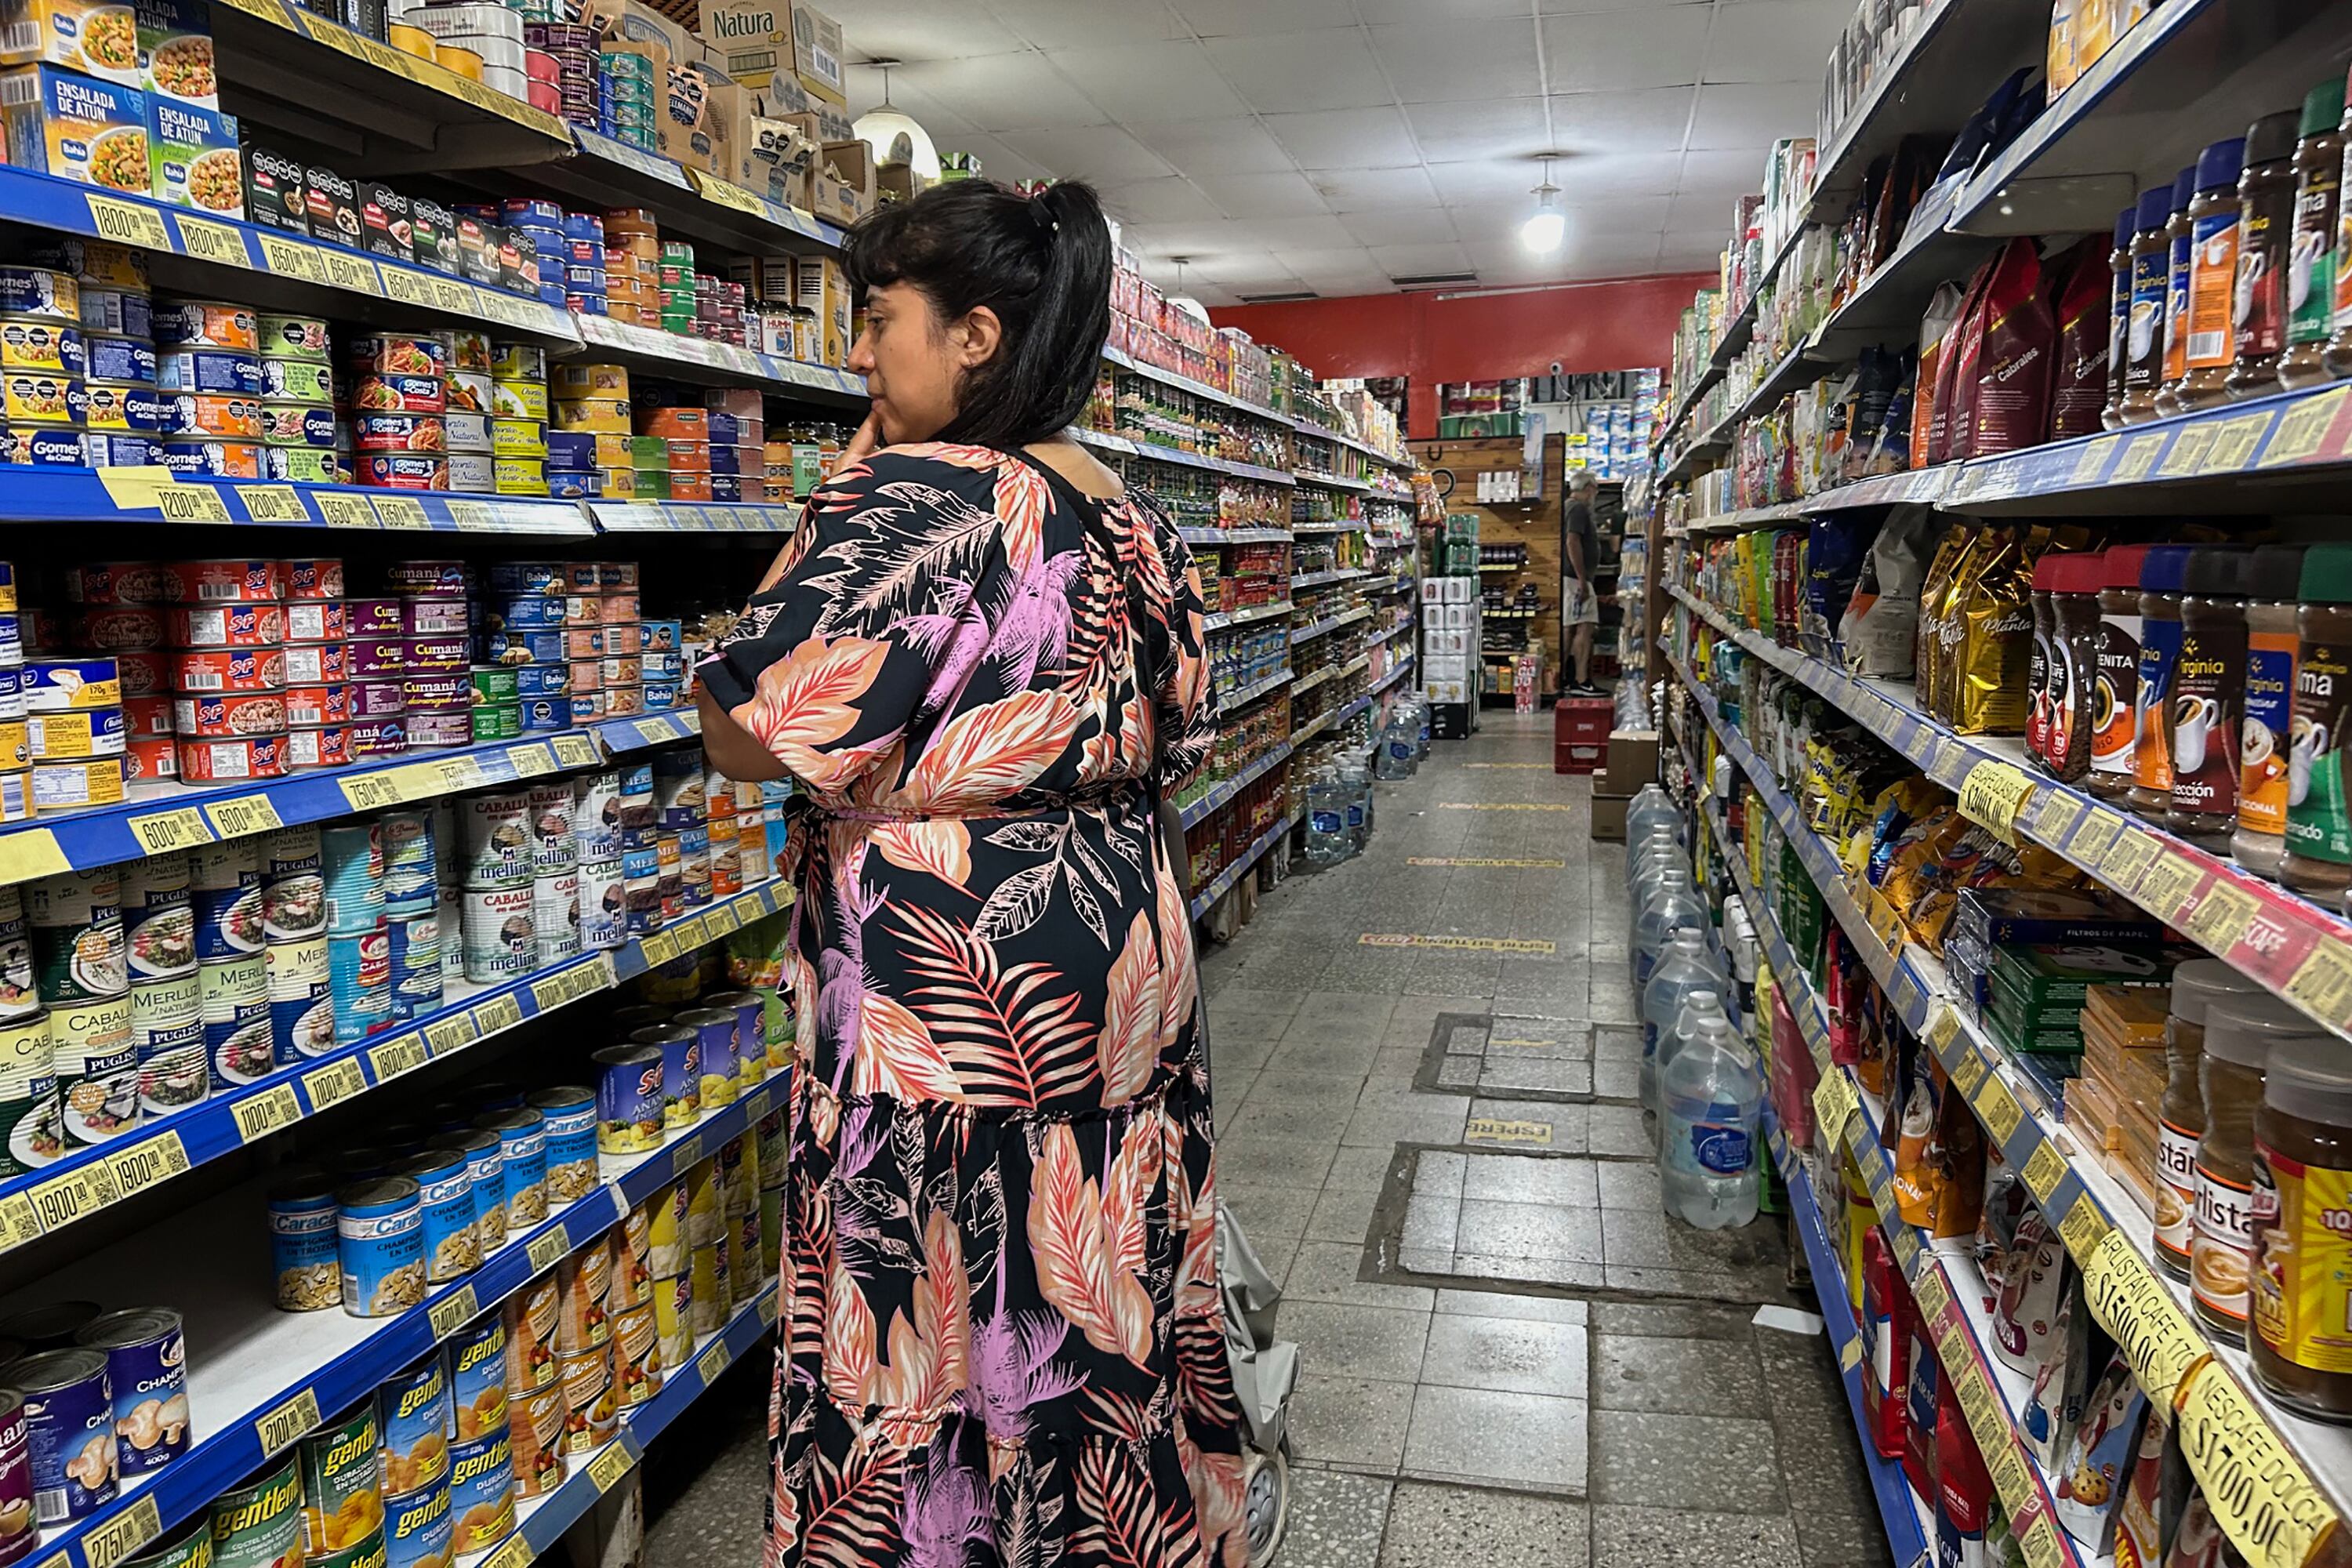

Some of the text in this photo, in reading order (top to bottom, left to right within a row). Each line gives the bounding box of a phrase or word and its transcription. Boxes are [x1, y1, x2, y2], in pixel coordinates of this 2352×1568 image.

[713, 10, 775, 39] Natura
[56, 80, 116, 111] ENSALADA
[58, 96, 107, 122] DE ATUN
[159, 107, 211, 134] ENSALADA
[161, 122, 201, 145] DE ATUN
[96, 205, 132, 238] 1800
[184, 224, 216, 256] 1800
[271, 245, 296, 273] 650
[330, 258, 353, 285] 650
[387, 273, 409, 298] 650
[437, 285, 458, 308] 650
[1998, 347, 2039, 383] Cabrales
[404, 379, 432, 390] Gomes
[372, 417, 401, 427] Gomes
[34, 441, 80, 456] Gomes
[162, 453, 204, 465] Gomes
[395, 459, 426, 470] Gomes
[158, 492, 194, 517] 1200
[244, 493, 276, 517] 1200
[321, 500, 350, 524] 1350
[378, 502, 405, 526] 1350
[388, 566, 441, 581] Cumaná
[527, 571, 550, 583] Bahía
[1980, 616, 2033, 633] Planta
[415, 641, 463, 655] Cumaná
[404, 679, 456, 695] Cumaná
[647, 689, 672, 702] Bahía
[443, 768, 464, 787] 750
[350, 785, 375, 808] 750
[475, 797, 528, 813] CABALLA
[218, 807, 248, 833] 600
[143, 821, 176, 849] 600
[154, 1025, 201, 1044] PUGLISI
[377, 1047, 402, 1078] 1800
[313, 1074, 338, 1105] 1100
[241, 1102, 268, 1136] 1100
[116, 1153, 151, 1192] 1900
[38, 1185, 78, 1227] 1900
[2099, 1234, 2153, 1304] ARLISTÁN
[2140, 1296, 2178, 1344] CAFE
[433, 1305, 456, 1340] 2401
[617, 1308, 651, 1334] Mora
[563, 1356, 601, 1380] Mora
[266, 1413, 290, 1451] 2101
[144, 1454, 170, 1466] 400g
[96, 1490, 114, 1505] 400g
[2263, 1452, 2326, 1532] DOLCA
[93, 1530, 124, 1568] 2751
